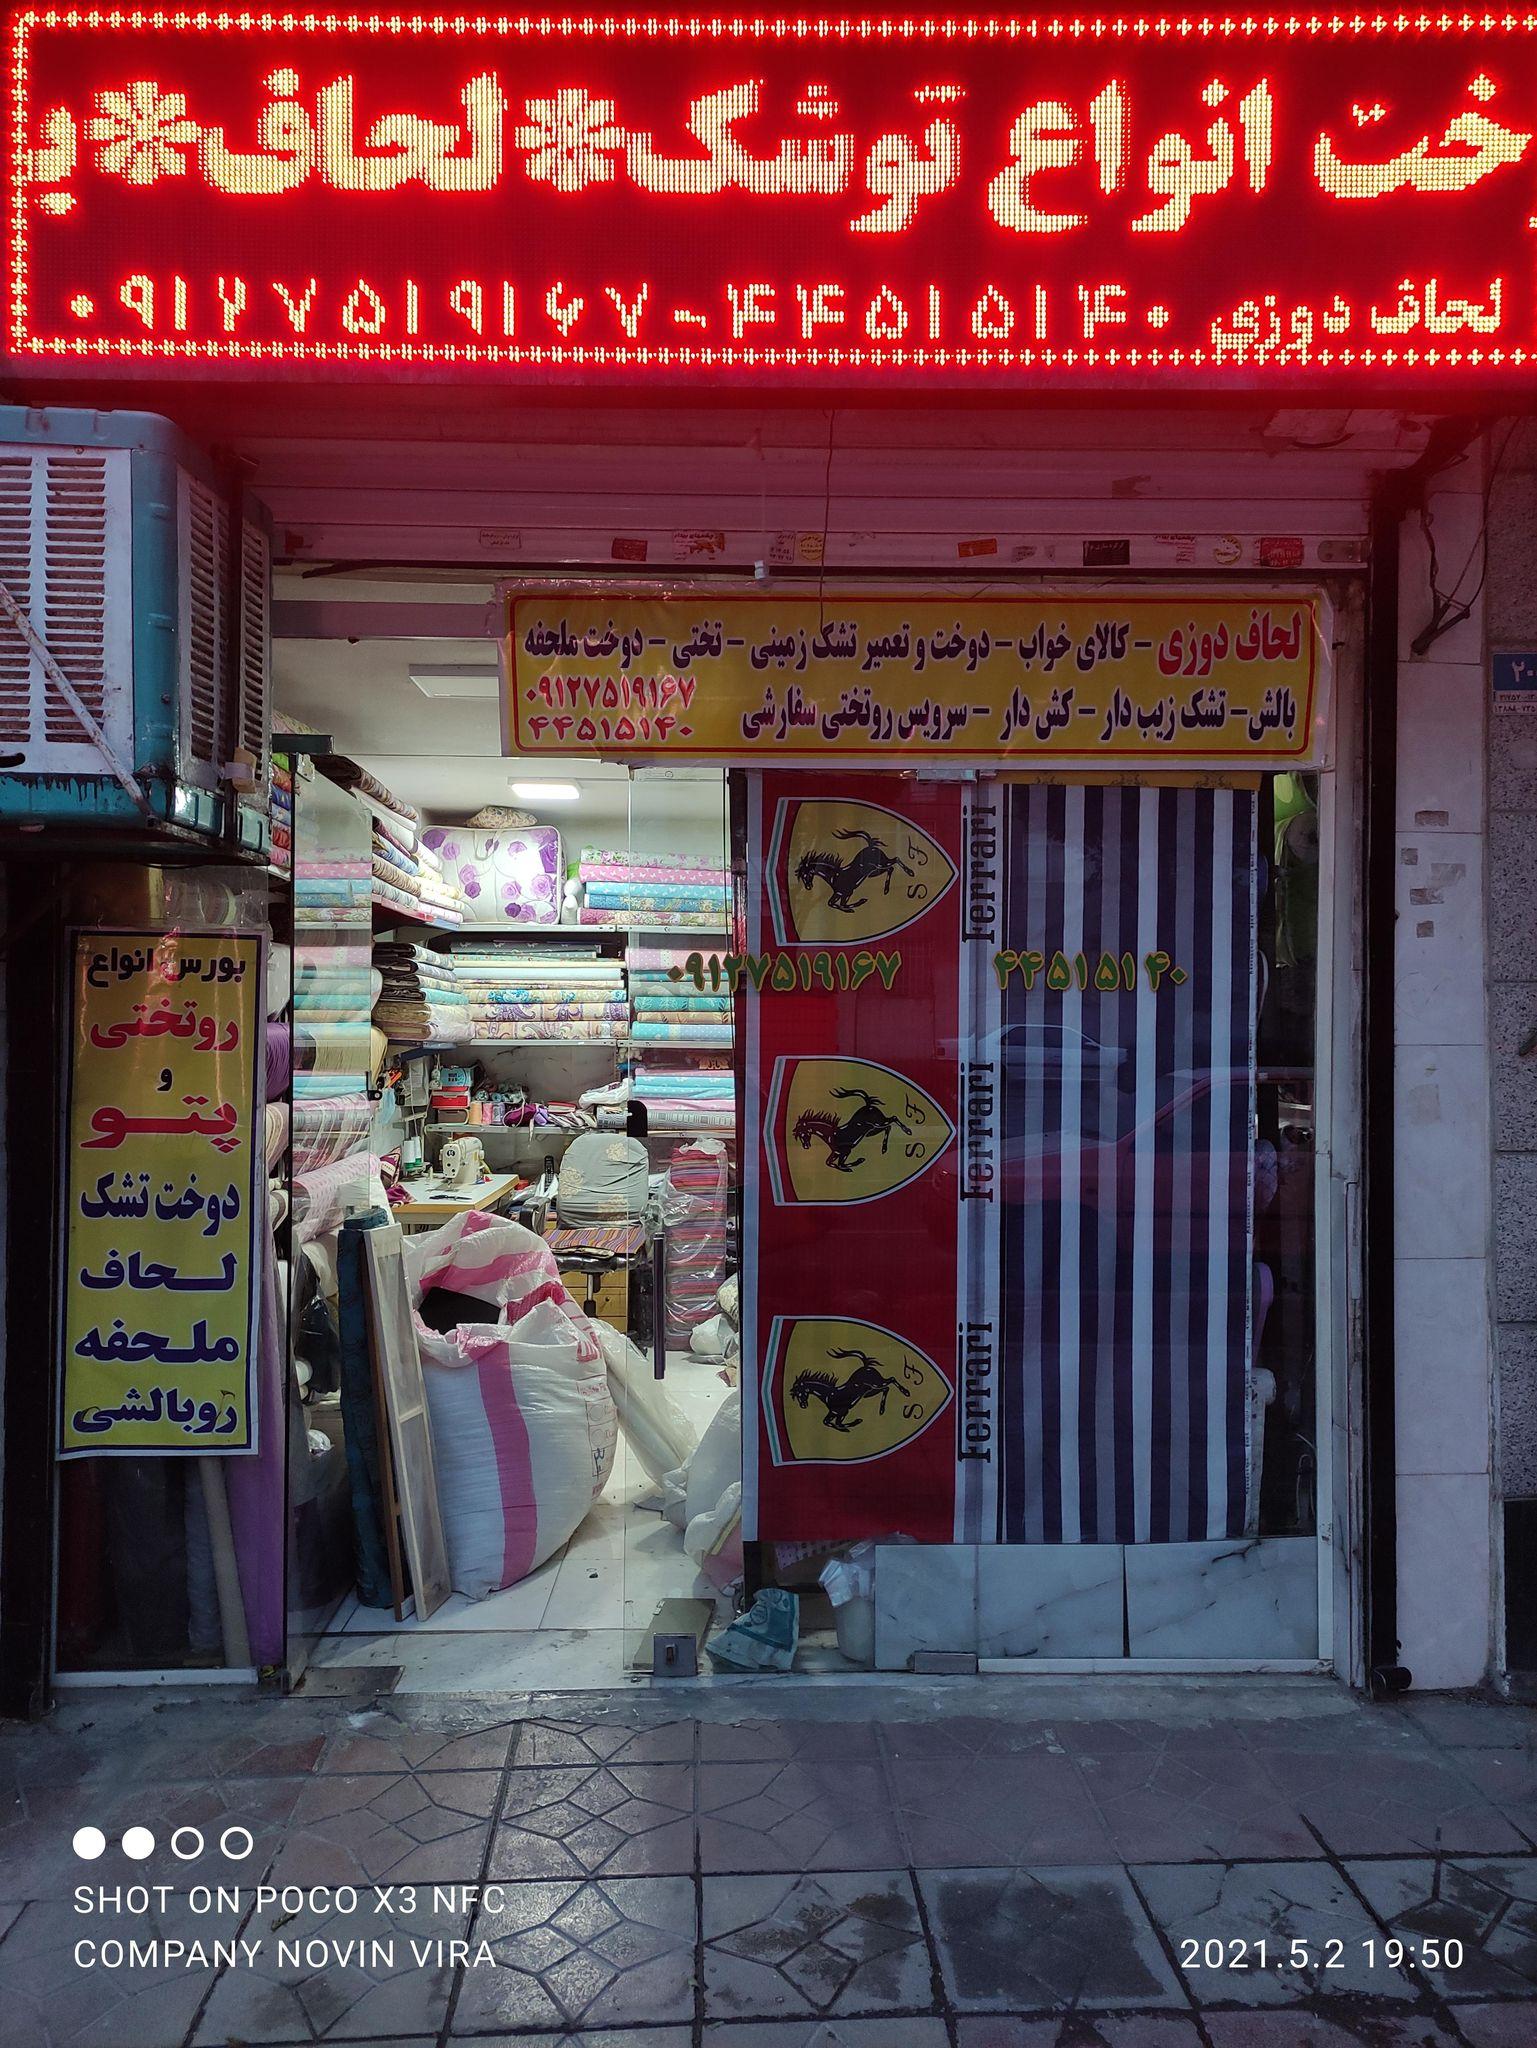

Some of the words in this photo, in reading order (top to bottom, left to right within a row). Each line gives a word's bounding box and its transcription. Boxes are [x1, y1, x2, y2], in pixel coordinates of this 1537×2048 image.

[199, 69, 506, 194] لحاف
[989, 79, 1272, 232] انواع
[627, 80, 965, 232] توشک
[1210, 294, 1352, 350] دوزی
[1372, 278, 1501, 333] لحاف
[525, 619, 579, 656] ملحفه
[583, 620, 643, 668] دوخت
[672, 620, 722, 668] تختی
[751, 627, 807, 669] زمینی
[812, 621, 858, 659] تشک
[861, 623, 910, 670] تعمیر
[914, 638, 926, 670] و
[930, 622, 990, 671] دوخت
[1018, 622, 1071, 671] خواب
[1077, 622, 1130, 670] کالای
[1158, 622, 1229, 676] دوزی
[1235, 609, 1302, 661] لحاف
[526, 675, 696, 708] ۰۹۱۲۷۵۱۹۱۶۷
[743, 686, 816, 739] سفارشی
[822, 687, 892, 739] روتختی
[1000, 687, 1030, 740] دار
[1035, 688, 1074, 740] کش
[1100, 688, 1132, 740] دار
[1180, 689, 1226, 728] تشک
[1249, 688, 1296, 740] بالش
[528, 716, 693, 740] ۴۴۵۱۵۱۴۰
[898, 699, 967, 740] سرویس
[1137, 697, 1176, 740] زیب
[962, 805, 996, 944] Ferrari
[87, 948, 154, 988] انواع
[160, 957, 246, 982] بورس
[667, 952, 902, 992] ۰۹۱۲۷۵۱۹۱۶۷
[91, 999, 239, 1051] روتختی
[157, 1068, 173, 1091] و
[79, 1096, 241, 1154] پتو
[960, 1062, 994, 1203] Ferrari
[80, 1172, 150, 1218] تشک
[155, 1173, 240, 1236] دوخت
[80, 1249, 237, 1291] لحاف
[75, 1319, 240, 1363] ملحفه
[73, 1387, 238, 1433] روبالشی
[958, 1322, 992, 1463] Ferrari
